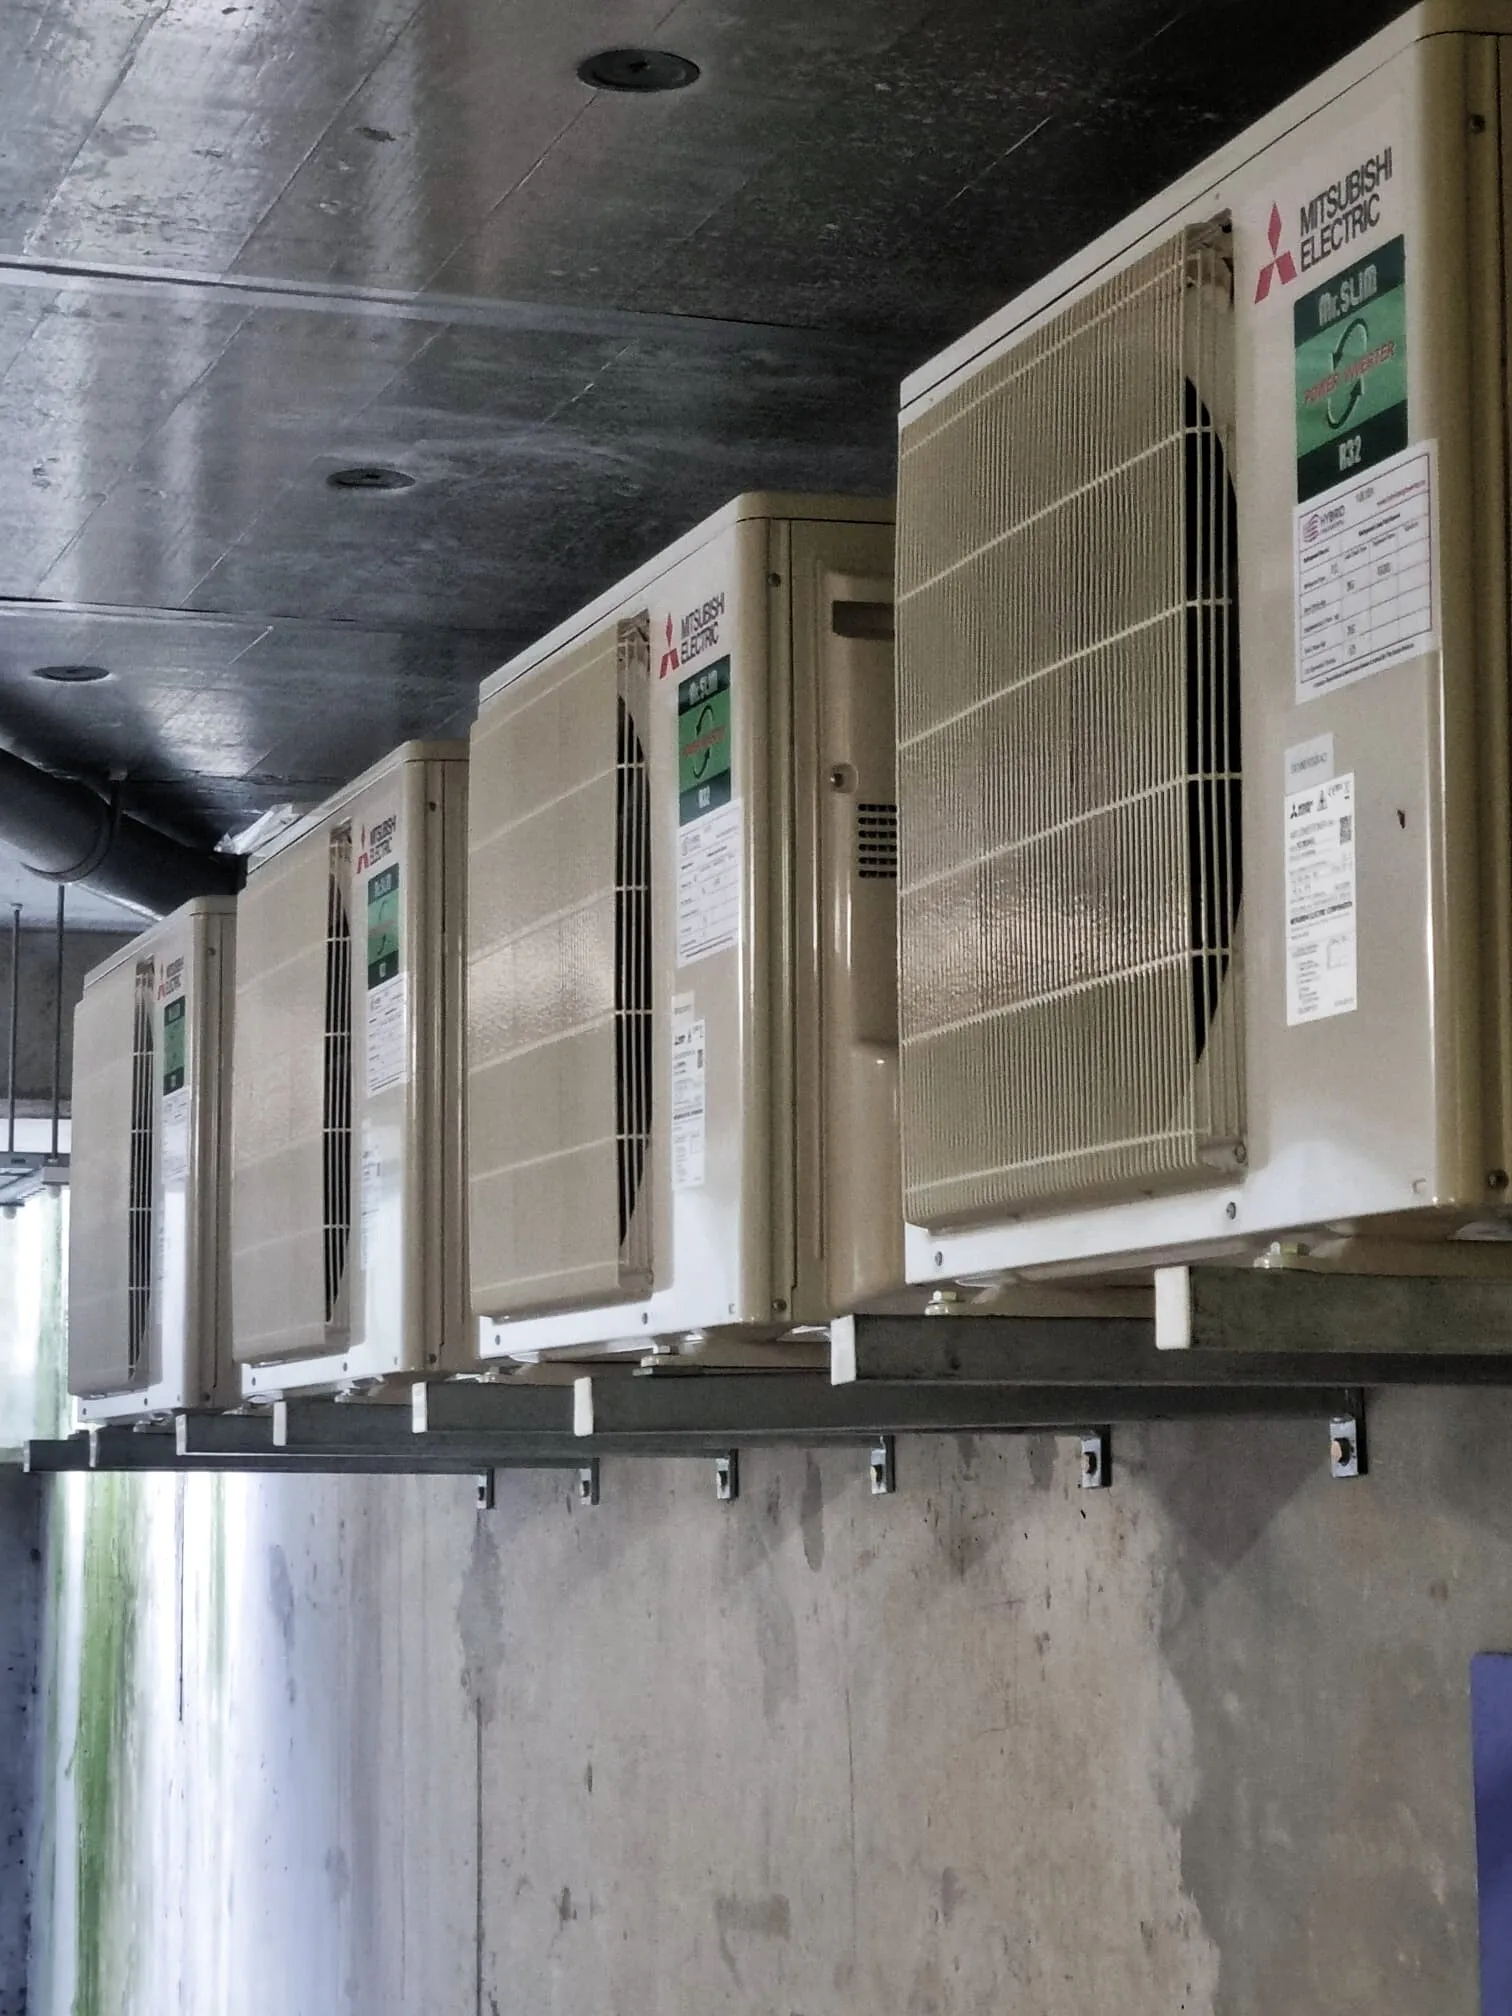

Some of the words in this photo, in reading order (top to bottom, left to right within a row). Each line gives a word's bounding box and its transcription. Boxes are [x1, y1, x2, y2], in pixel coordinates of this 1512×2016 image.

[1300, 146, 1393, 236] MITSUBISHI
[1300, 194, 1381, 273] ELECTRIC
[1338, 435, 1362, 472] R32
[681, 592, 725, 640] MITSUBISHI
[681, 621, 719, 665] ELECTRIC
